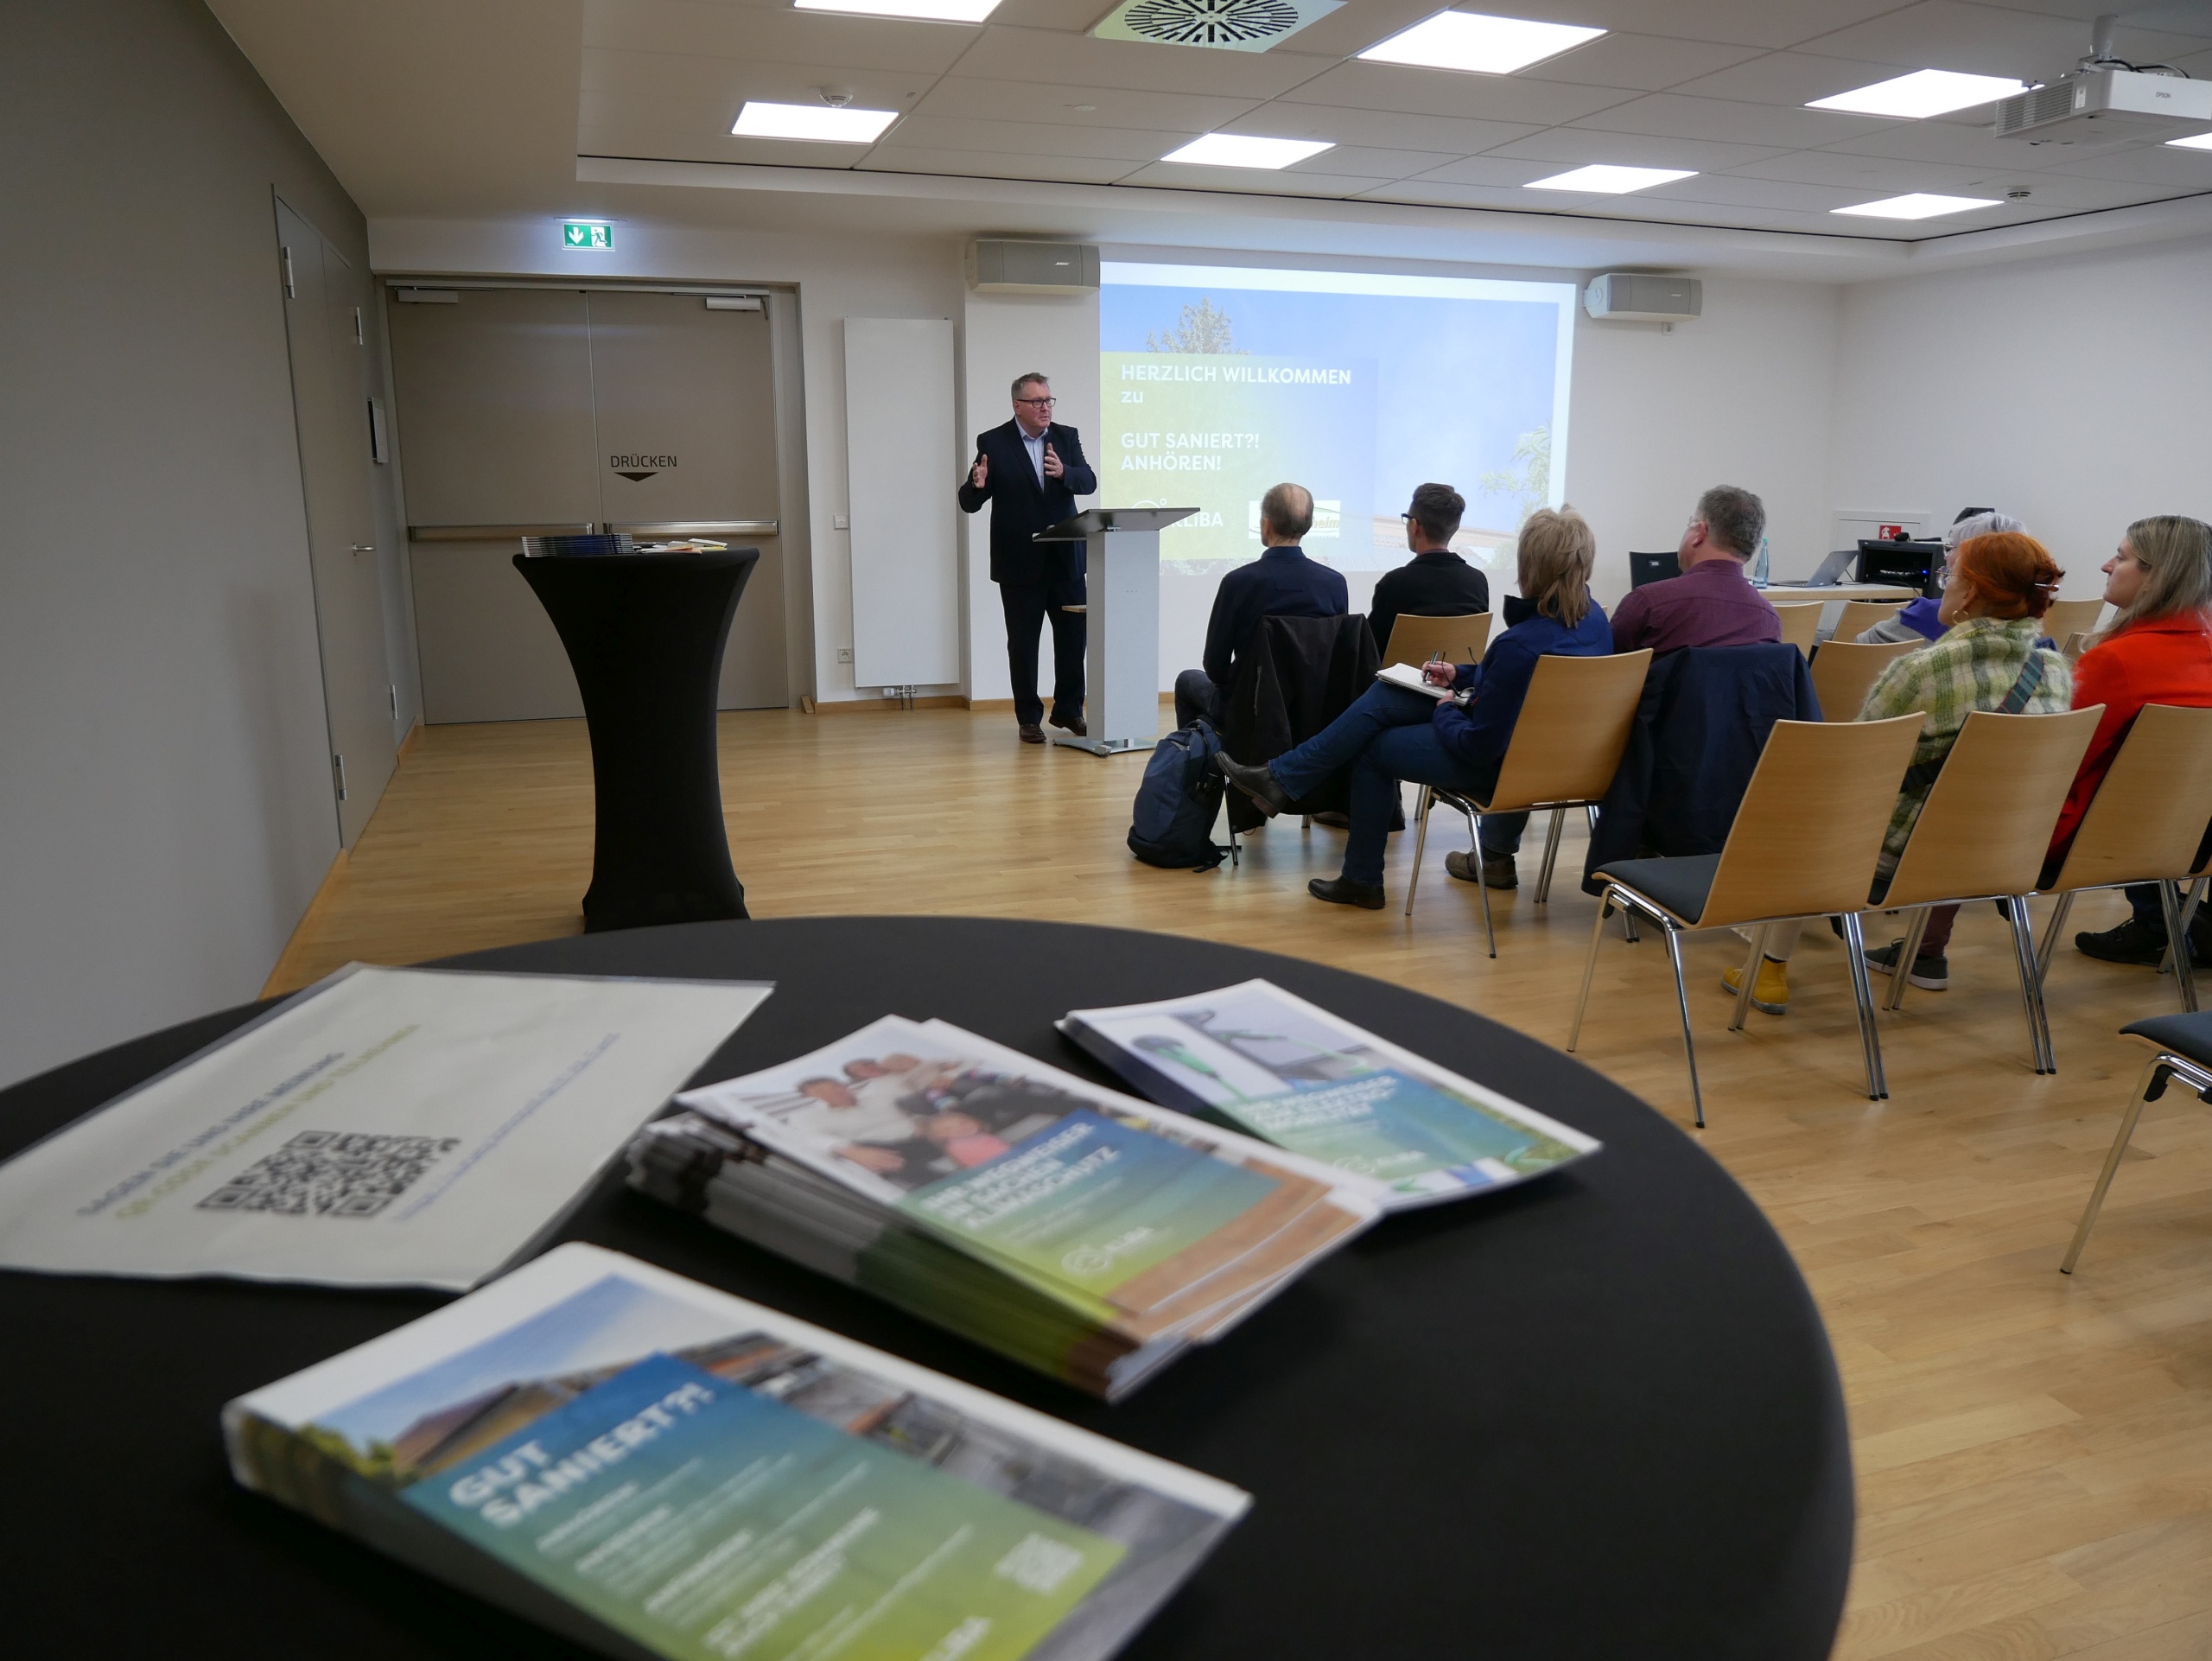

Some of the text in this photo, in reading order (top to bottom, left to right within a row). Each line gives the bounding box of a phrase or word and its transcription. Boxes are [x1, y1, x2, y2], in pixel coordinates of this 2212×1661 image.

[1122, 364, 1351, 385] HERZLICH WILLKOMMEN
[1121, 432, 1259, 449] GUT SANIERT?!
[610, 453, 677, 468] DRÜCKEN
[1120, 450, 1222, 471] ANHÖREN!
[480, 1382, 715, 1529] SANIERT?!
[450, 1438, 550, 1507] GUT
